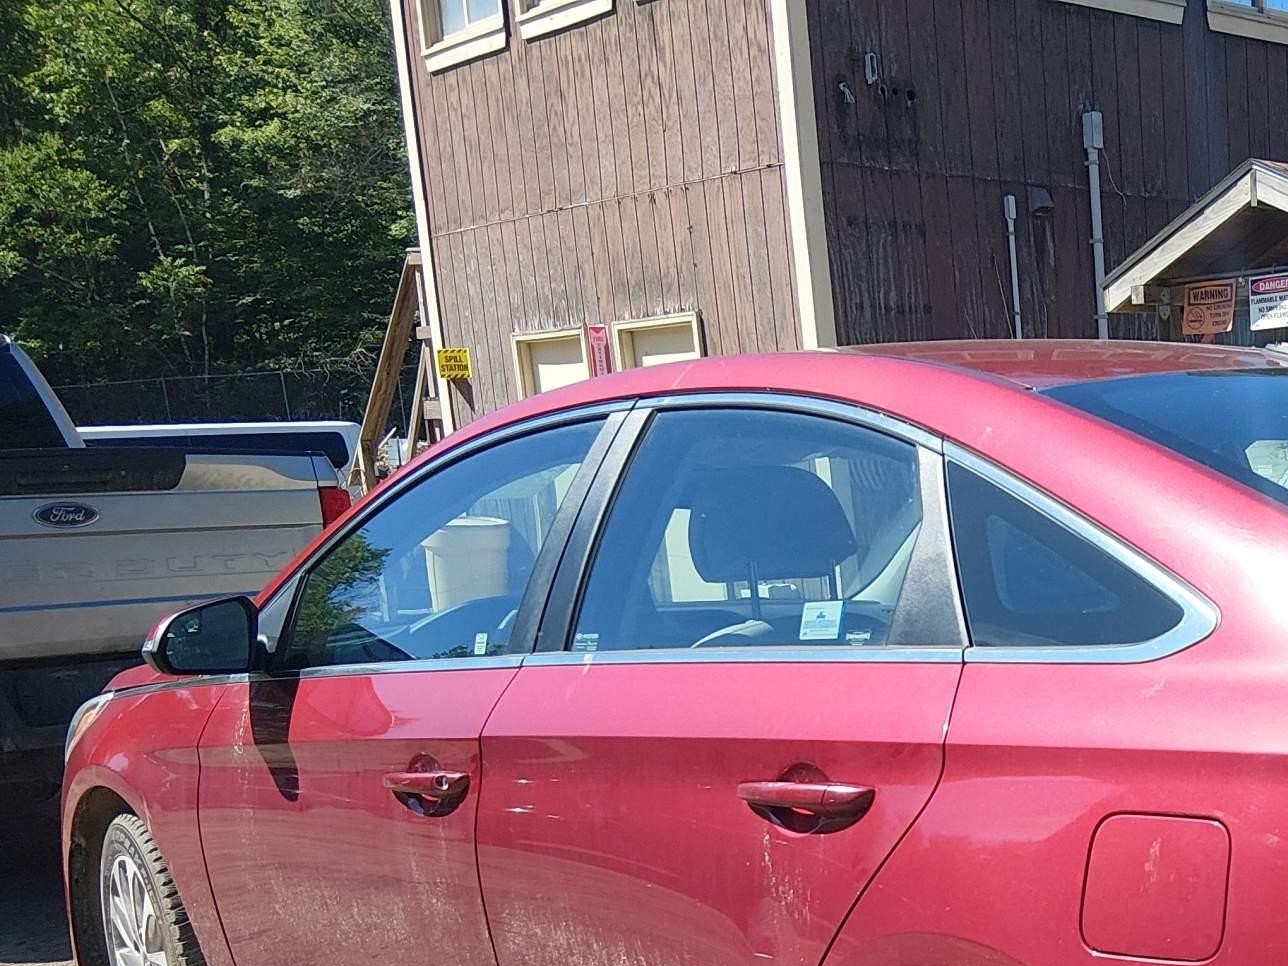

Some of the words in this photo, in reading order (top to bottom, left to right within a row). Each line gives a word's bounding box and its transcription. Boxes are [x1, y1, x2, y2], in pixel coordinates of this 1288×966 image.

[1192, 287, 1229, 302] WARNING
[444, 355, 464, 363] SPILL
[50, 507, 85, 521] Ford
[113, 551, 289, 576] DUTY
